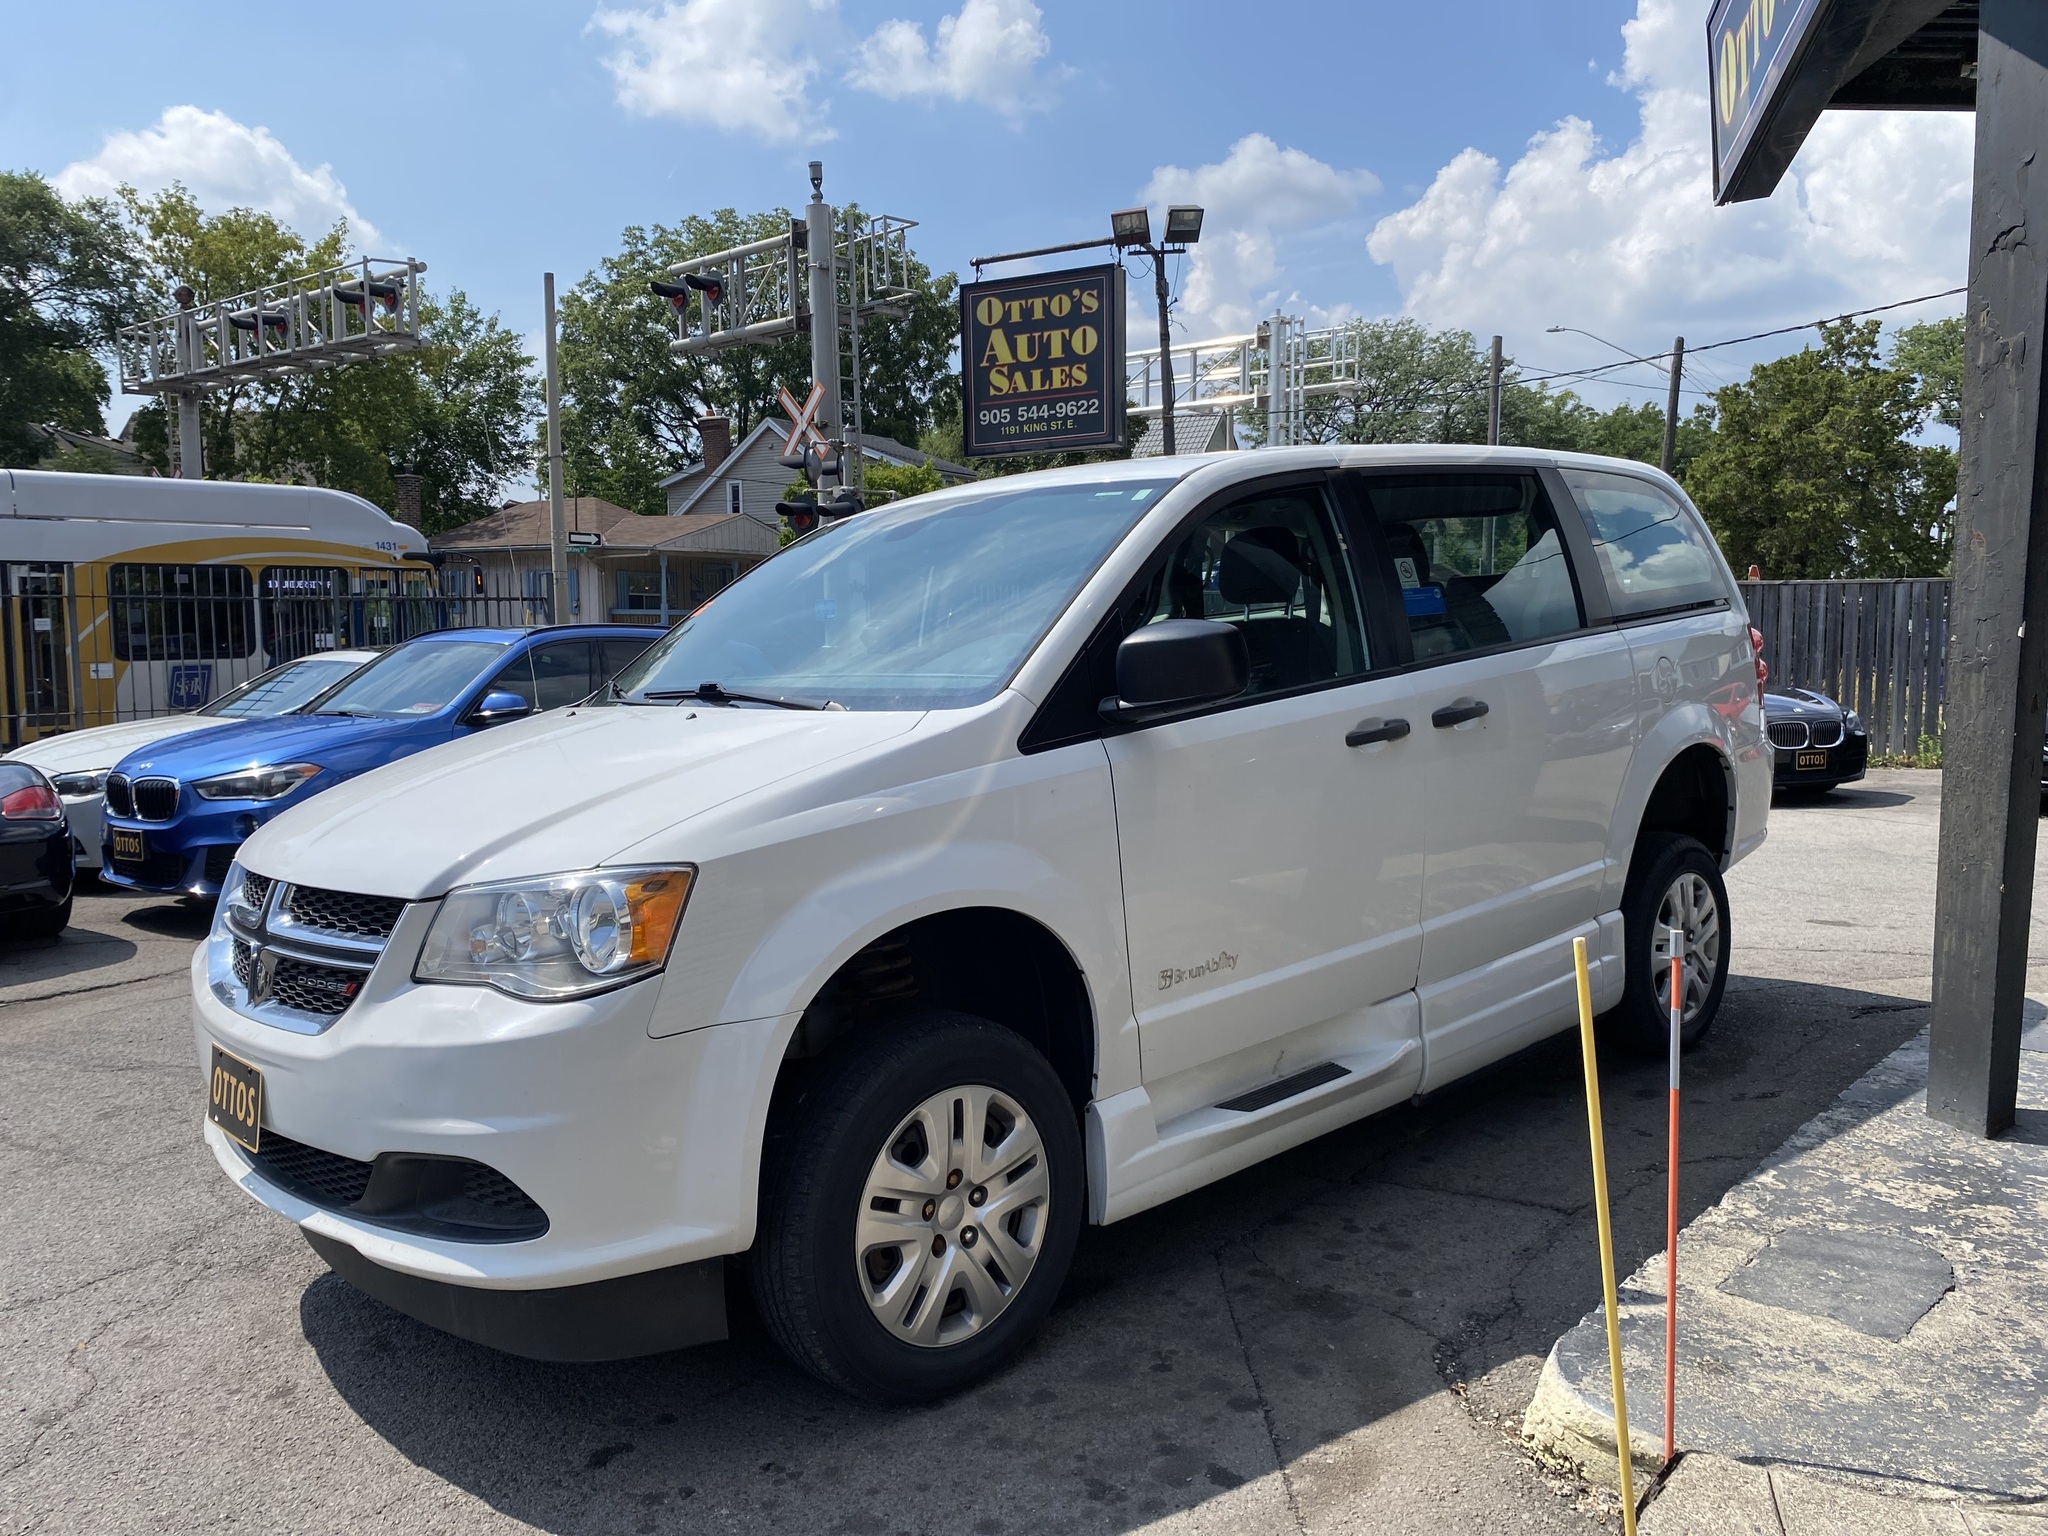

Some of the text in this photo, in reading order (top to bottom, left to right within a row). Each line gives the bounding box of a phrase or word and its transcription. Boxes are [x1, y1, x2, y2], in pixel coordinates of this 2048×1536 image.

[976, 289, 1099, 326] OTTO'S
[980, 325, 1098, 367] AUTO
[989, 363, 1088, 396] SALES
[979, 398, 1099, 425] 905 544-9622
[1000, 419, 1077, 435] 1191 KING ST. E.
[375, 541, 397, 550] 1431
[1799, 754, 1824, 765] OTTOS
[115, 836, 140, 853] OTTOS
[297, 975, 347, 992] DODGE
[213, 1066, 256, 1128] OTTOS
